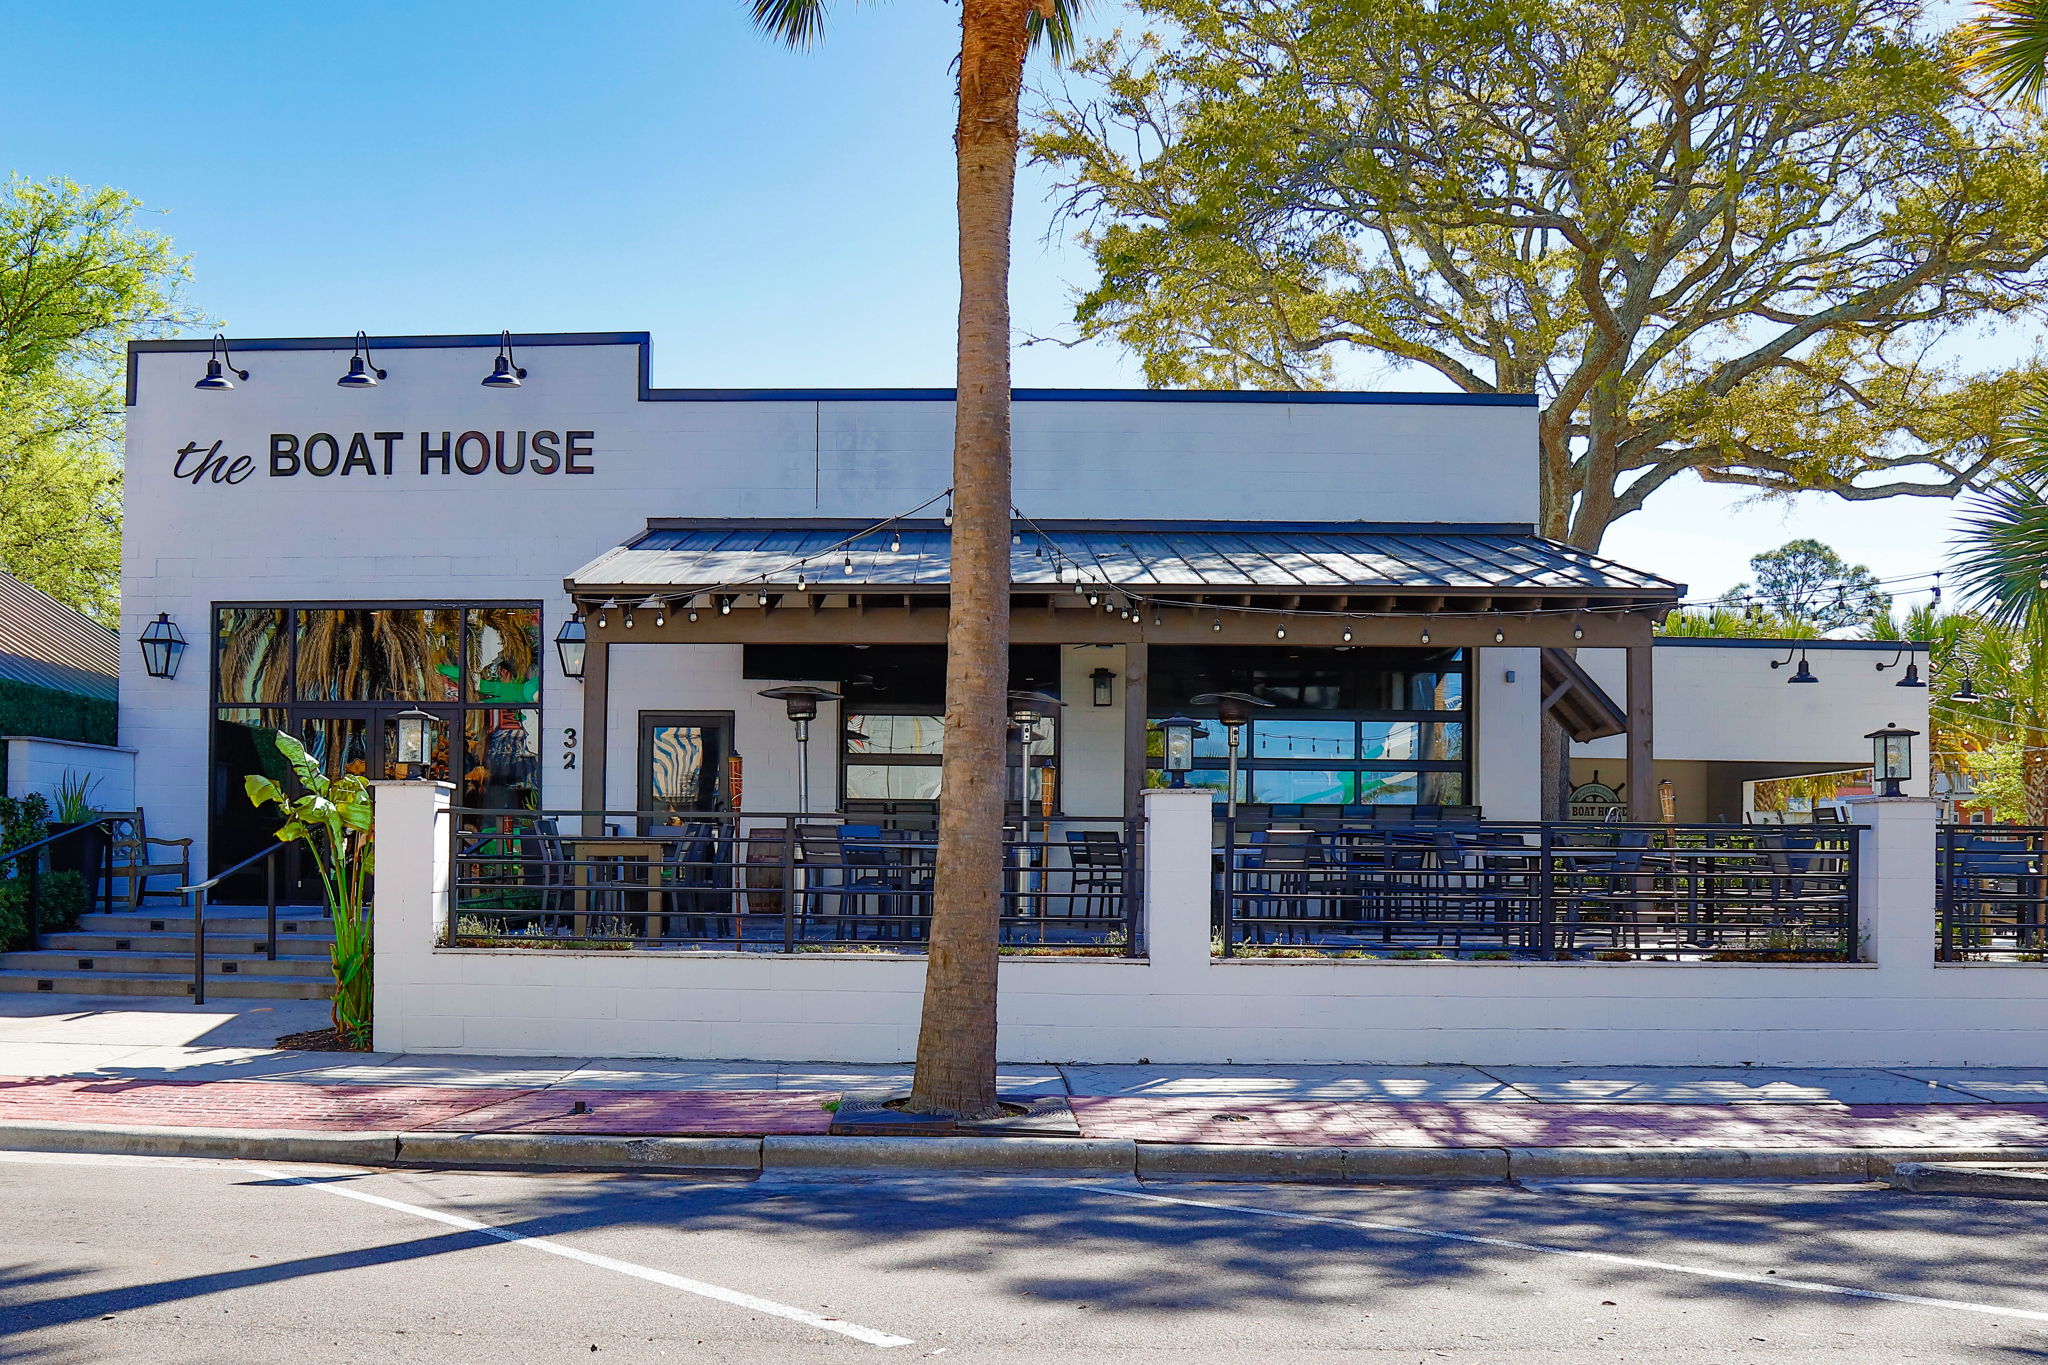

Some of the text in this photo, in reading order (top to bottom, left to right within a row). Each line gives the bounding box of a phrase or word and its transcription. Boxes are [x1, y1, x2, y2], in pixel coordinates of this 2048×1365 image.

[174, 430, 595, 485] the BOAT HOUSE
[562, 727, 578, 770] 32
[1572, 806, 1628, 816] BOAT HOE
